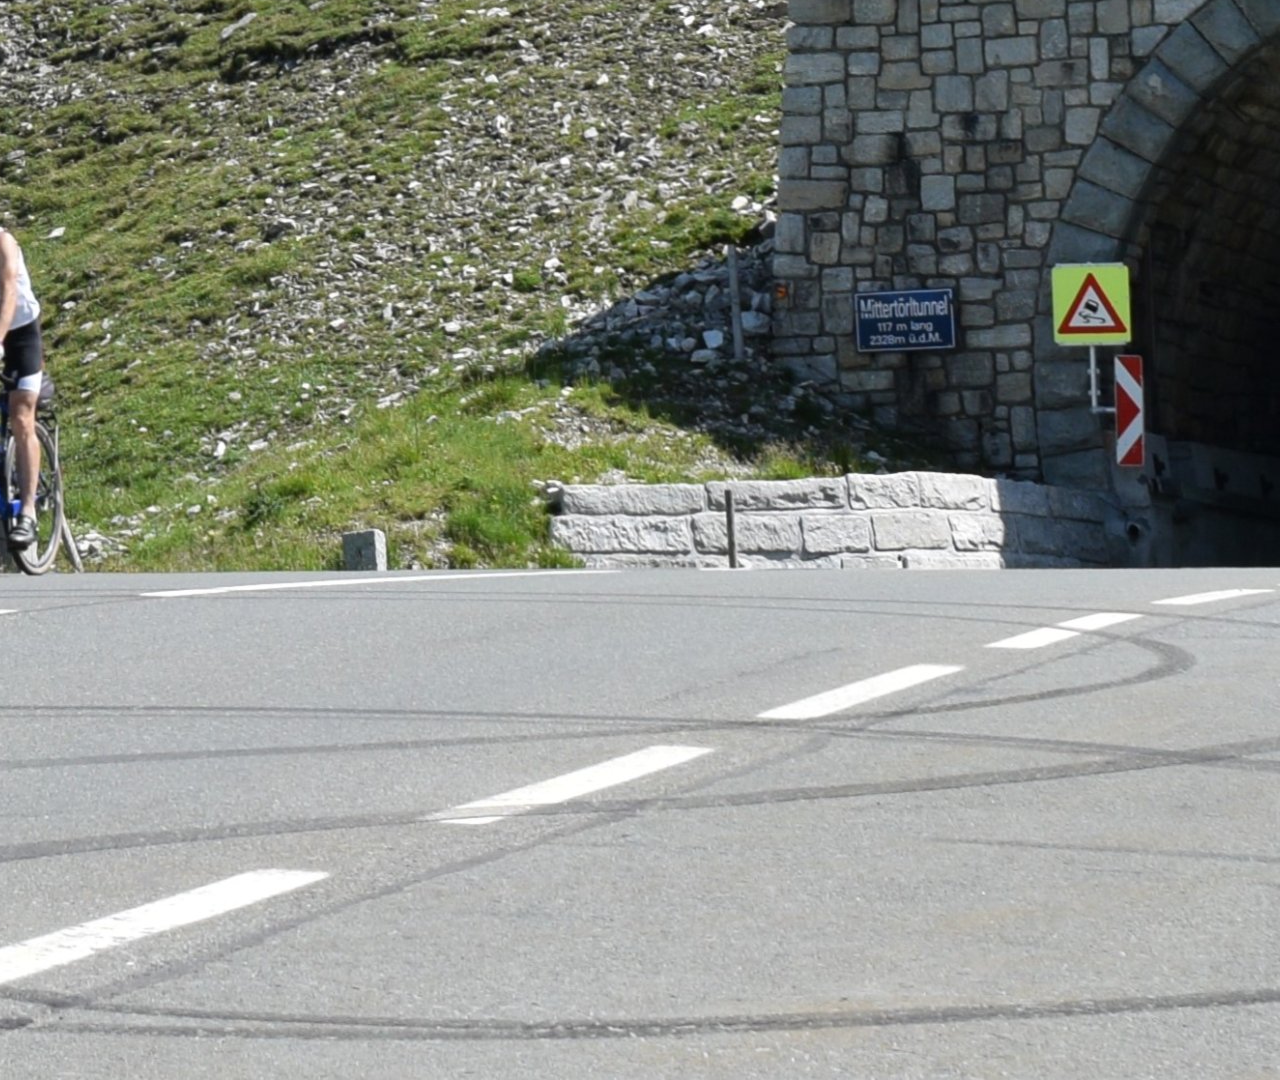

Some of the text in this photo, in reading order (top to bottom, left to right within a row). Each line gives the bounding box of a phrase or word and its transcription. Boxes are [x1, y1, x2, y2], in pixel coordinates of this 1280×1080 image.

[860, 294, 949, 319] Mittertörltunnel
[877, 320, 934, 332] 117 m lang
[869, 334, 906, 346] 2328m
